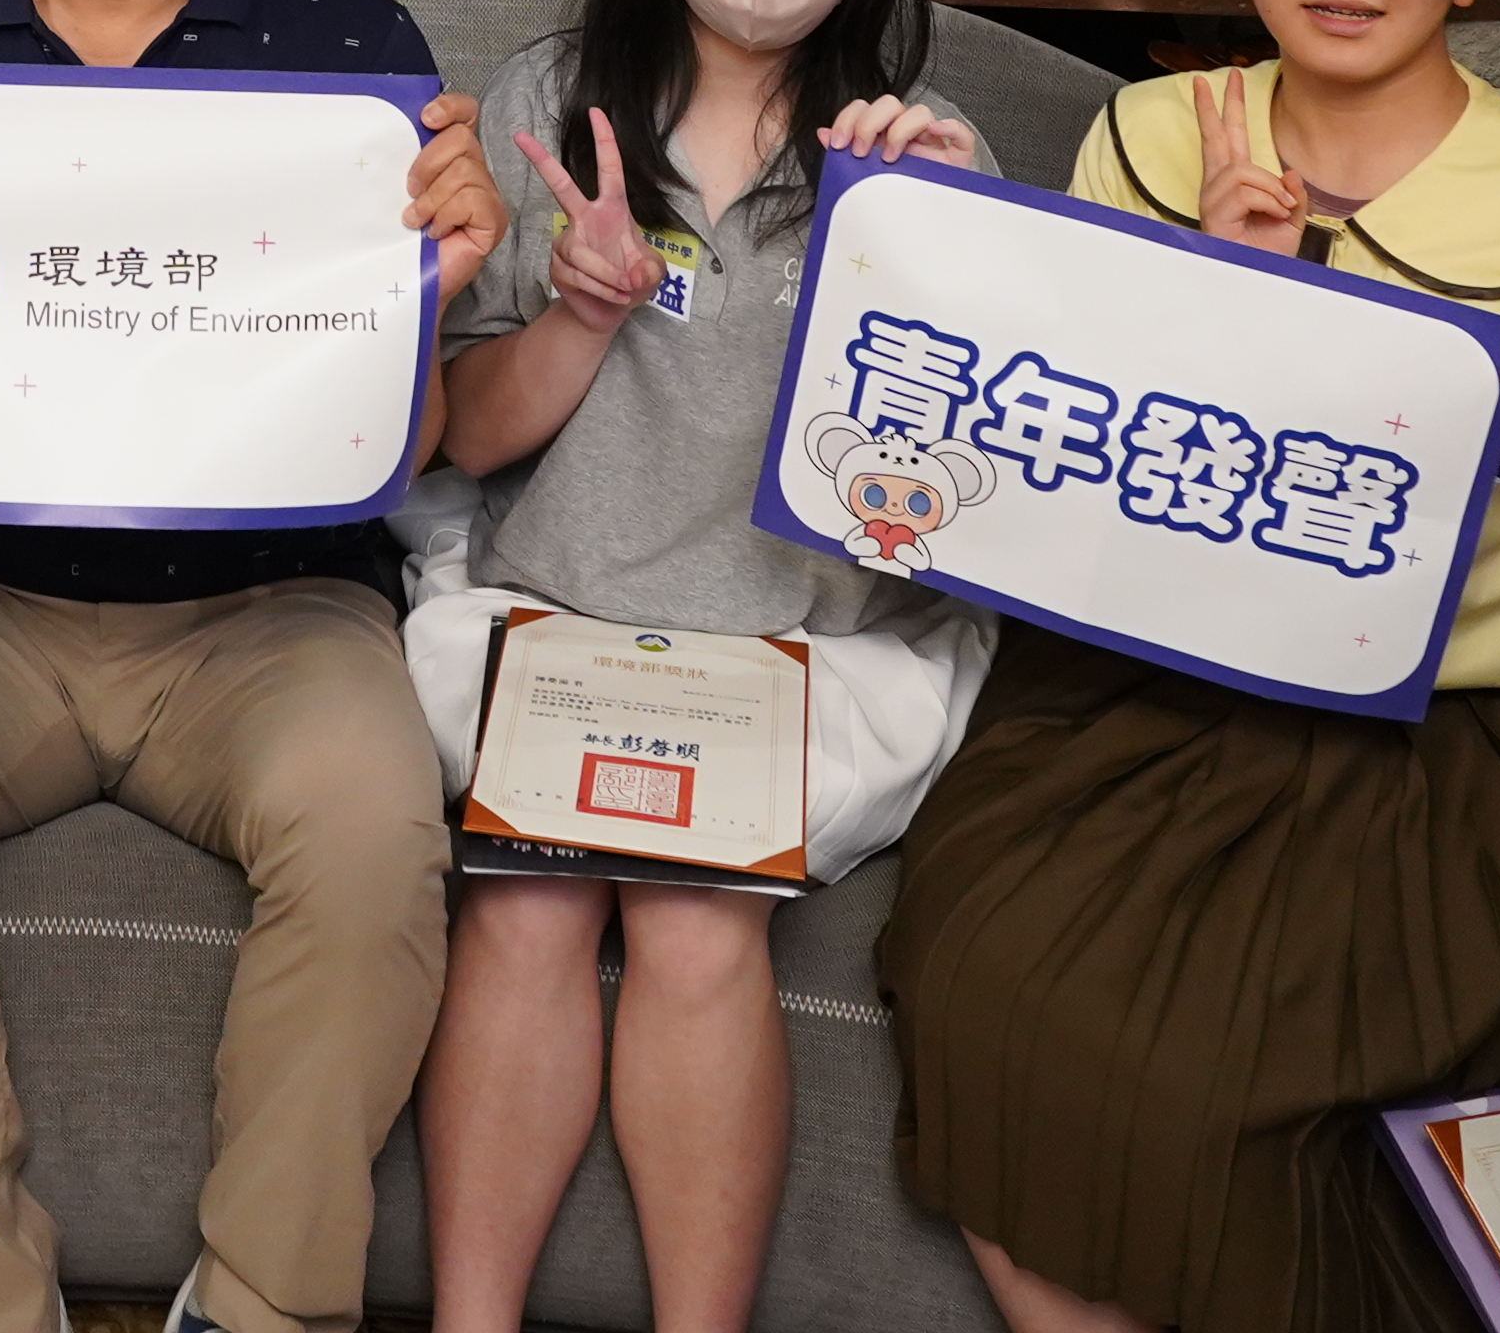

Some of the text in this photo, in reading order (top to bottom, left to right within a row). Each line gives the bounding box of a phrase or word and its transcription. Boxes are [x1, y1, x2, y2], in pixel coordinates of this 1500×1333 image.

[27, 244, 220, 292] 環境部
[25, 300, 379, 337] Ministry of Environment
[845, 309, 1420, 579] 青年發聲
